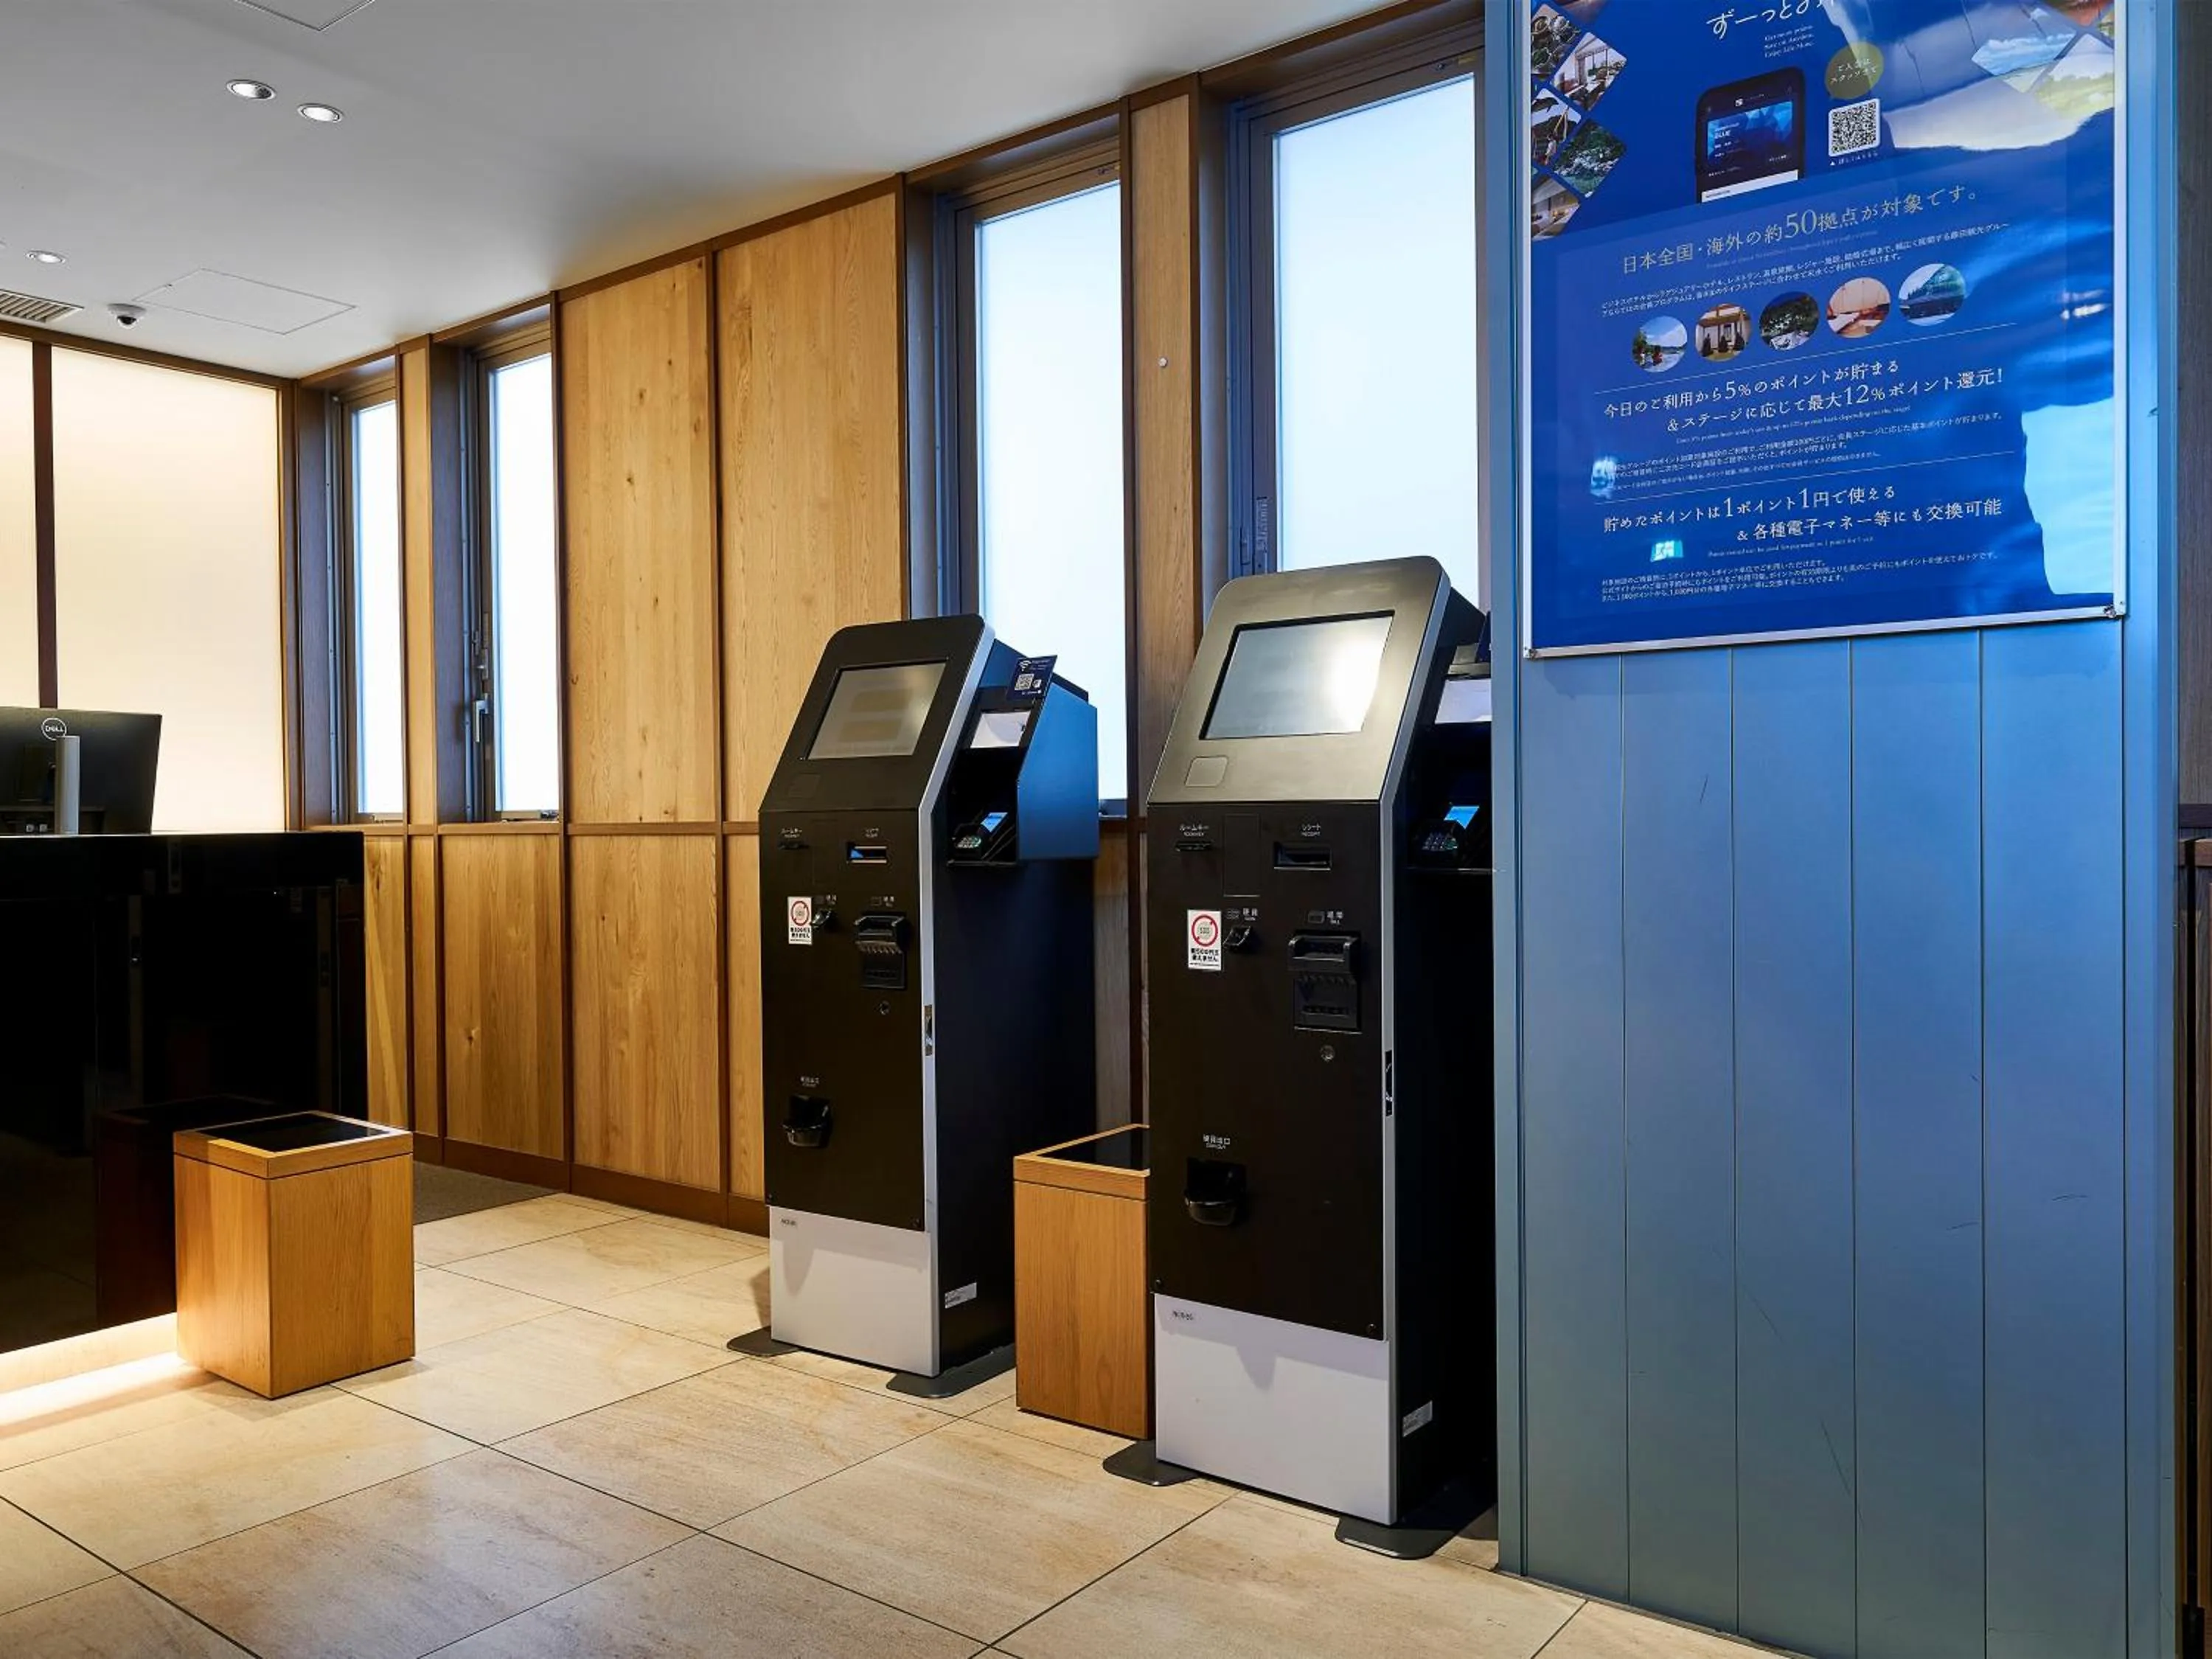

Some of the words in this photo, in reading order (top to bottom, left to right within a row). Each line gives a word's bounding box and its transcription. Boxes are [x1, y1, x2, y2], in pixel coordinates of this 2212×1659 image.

[1706, 0, 1834, 39] ずーっと
[1624, 185, 1975, 274] 日本全国・海外の約50拠点が対象です。
[1604, 360, 1899, 418] 今日のご利用から5%のポイントが貯まる
[1604, 486, 1895, 532] 貯めたポイントは1ポイント1円で使える
